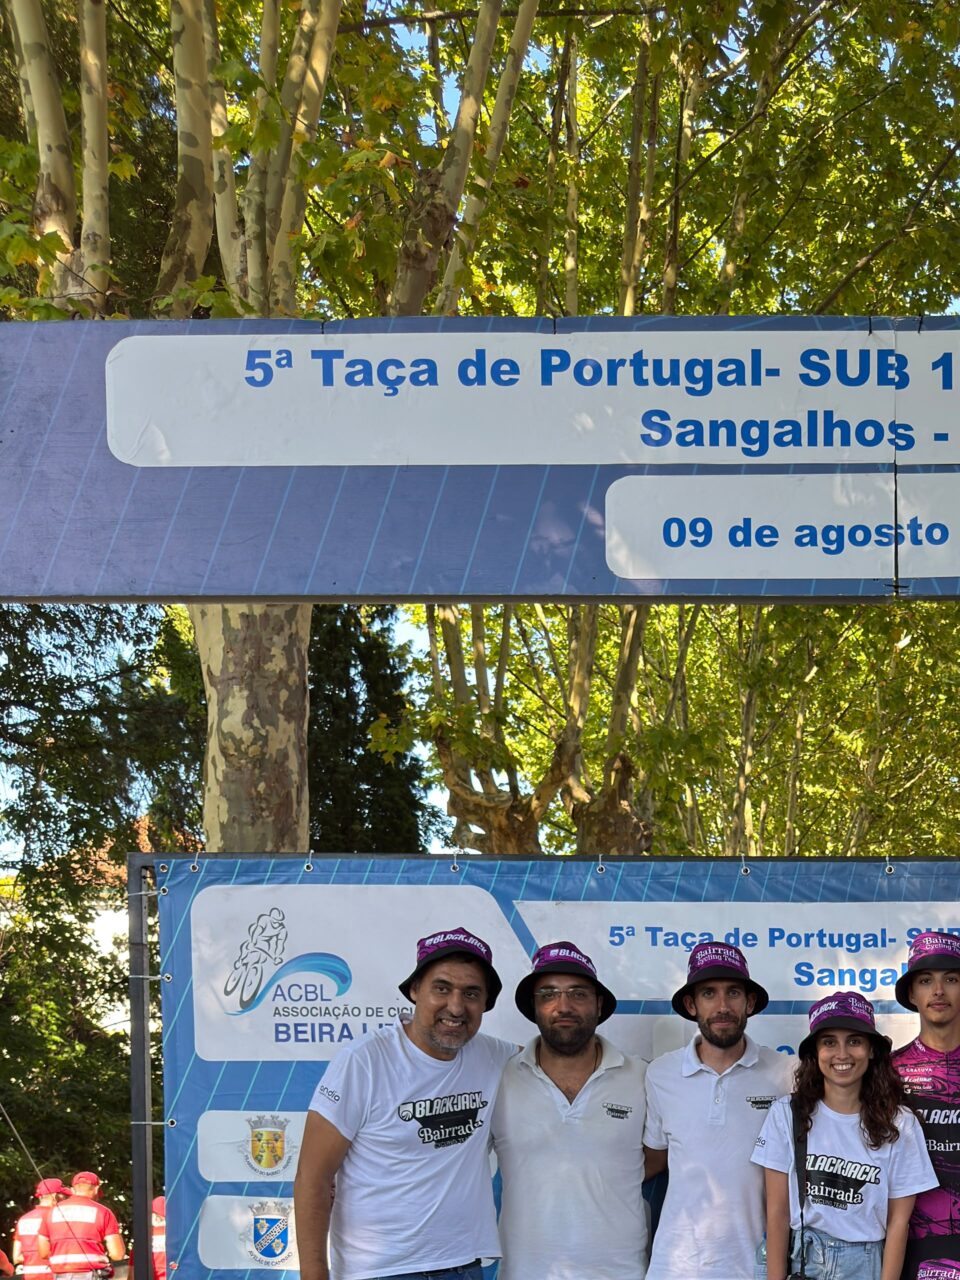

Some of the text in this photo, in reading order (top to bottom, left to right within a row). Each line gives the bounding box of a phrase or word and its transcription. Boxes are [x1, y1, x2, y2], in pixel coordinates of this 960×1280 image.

[245, 349, 292, 388] 5ª
[311, 349, 437, 397] Taça
[458, 348, 520, 387] de
[541, 349, 780, 397] Portugal-
[800, 348, 911, 390] SUB
[639, 409, 916, 458] Sangalhos
[662, 517, 713, 549] 09
[728, 517, 779, 548] de
[794, 517, 949, 555] agosto
[609, 925, 637, 948] 5ª
[644, 926, 715, 953] Taça
[723, 927, 759, 948] de
[768, 928, 896, 952] Portugal-
[793, 961, 908, 992] Sanga
[272, 984, 333, 1002] ACBL
[273, 1004, 361, 1020] ASSOCIAÇÃO
[366, 1007, 384, 1018] DE
[274, 1022, 354, 1043] BEIRA
[414, 1091, 483, 1119] BLACKJACK
[419, 1119, 483, 1143] Bairrada
[806, 1181, 863, 1204] Bairrada
